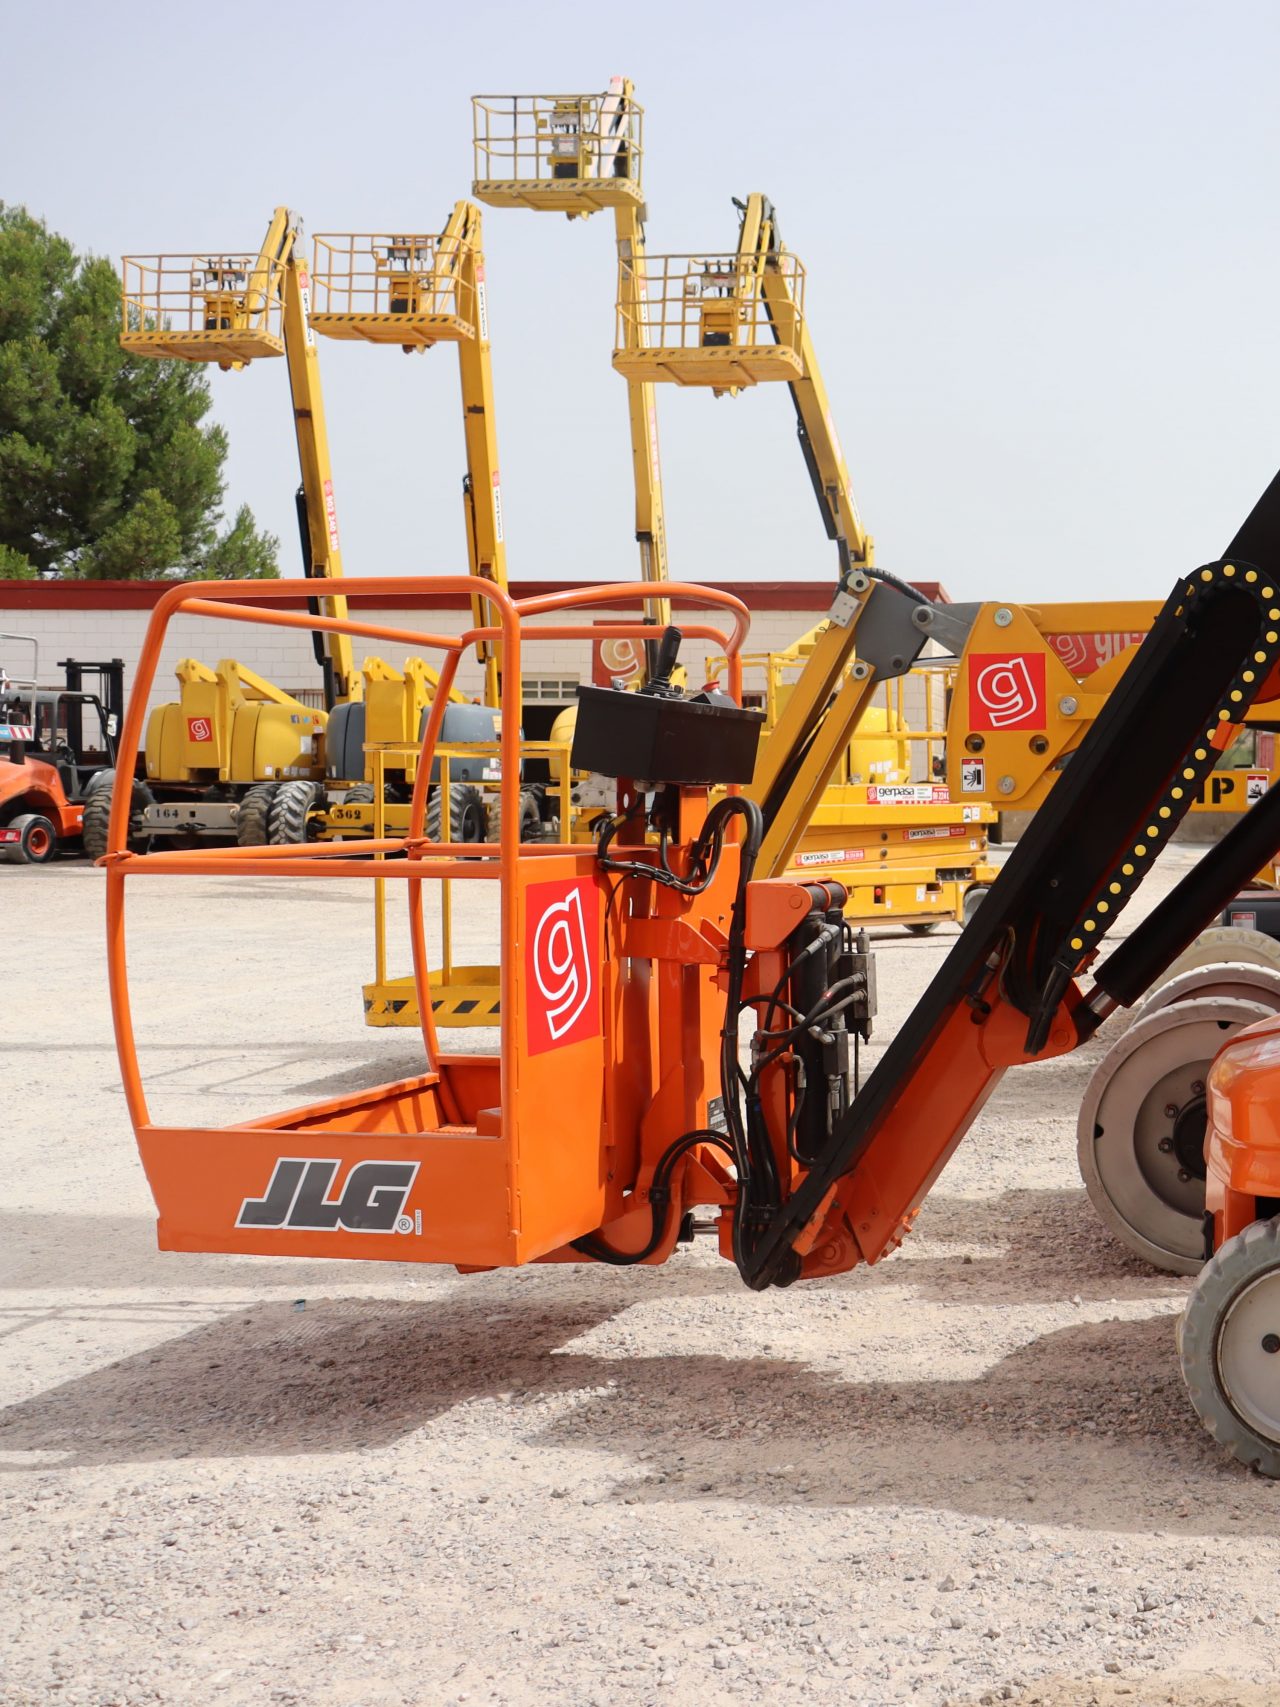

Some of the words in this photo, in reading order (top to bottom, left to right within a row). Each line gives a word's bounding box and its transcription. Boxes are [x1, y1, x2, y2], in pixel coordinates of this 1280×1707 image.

[878, 787, 915, 798] gerpasa
[155, 808, 179, 819] 164
[336, 808, 361, 820] 362
[234, 1157, 422, 1235] JLG
